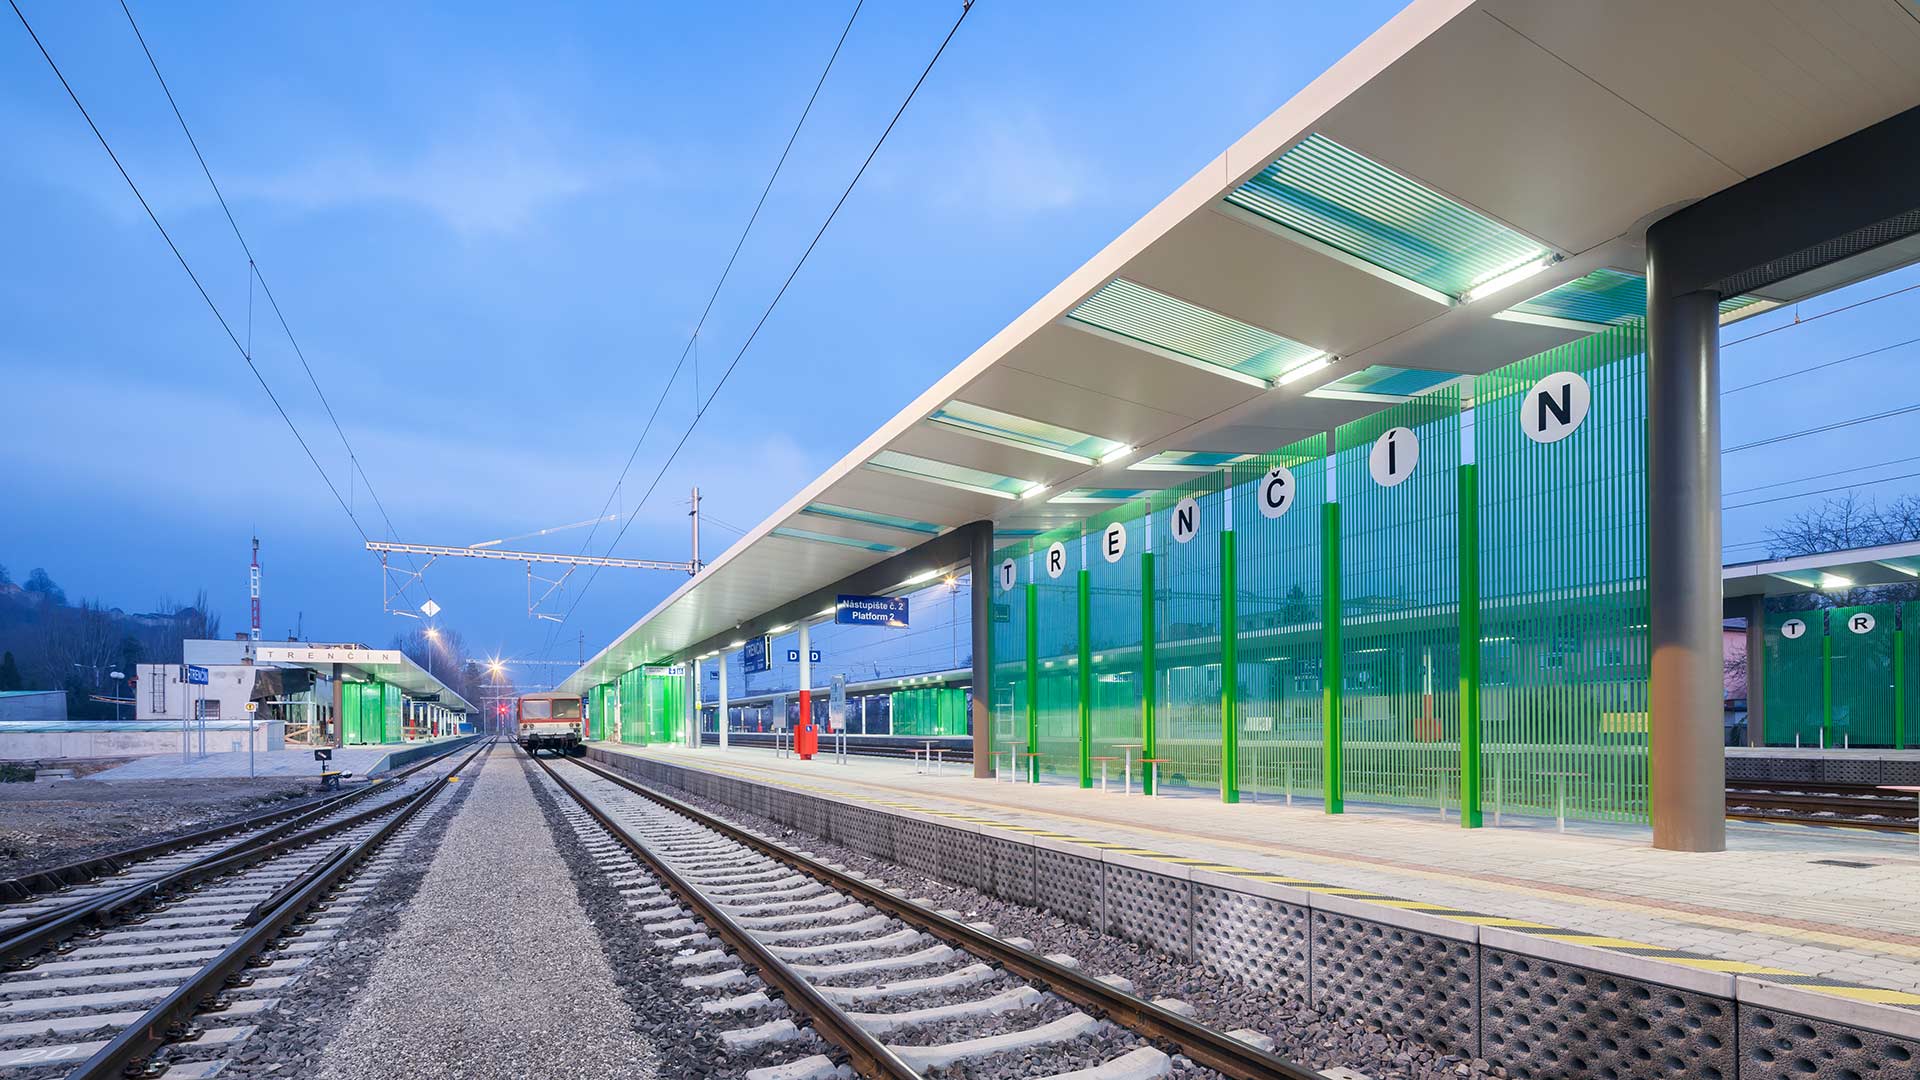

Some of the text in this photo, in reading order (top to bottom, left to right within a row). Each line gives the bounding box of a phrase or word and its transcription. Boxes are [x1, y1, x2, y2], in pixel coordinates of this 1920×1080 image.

[852, 611, 888, 621] Platform
[790, 651, 798, 660] D
[811, 652, 819, 661] D
